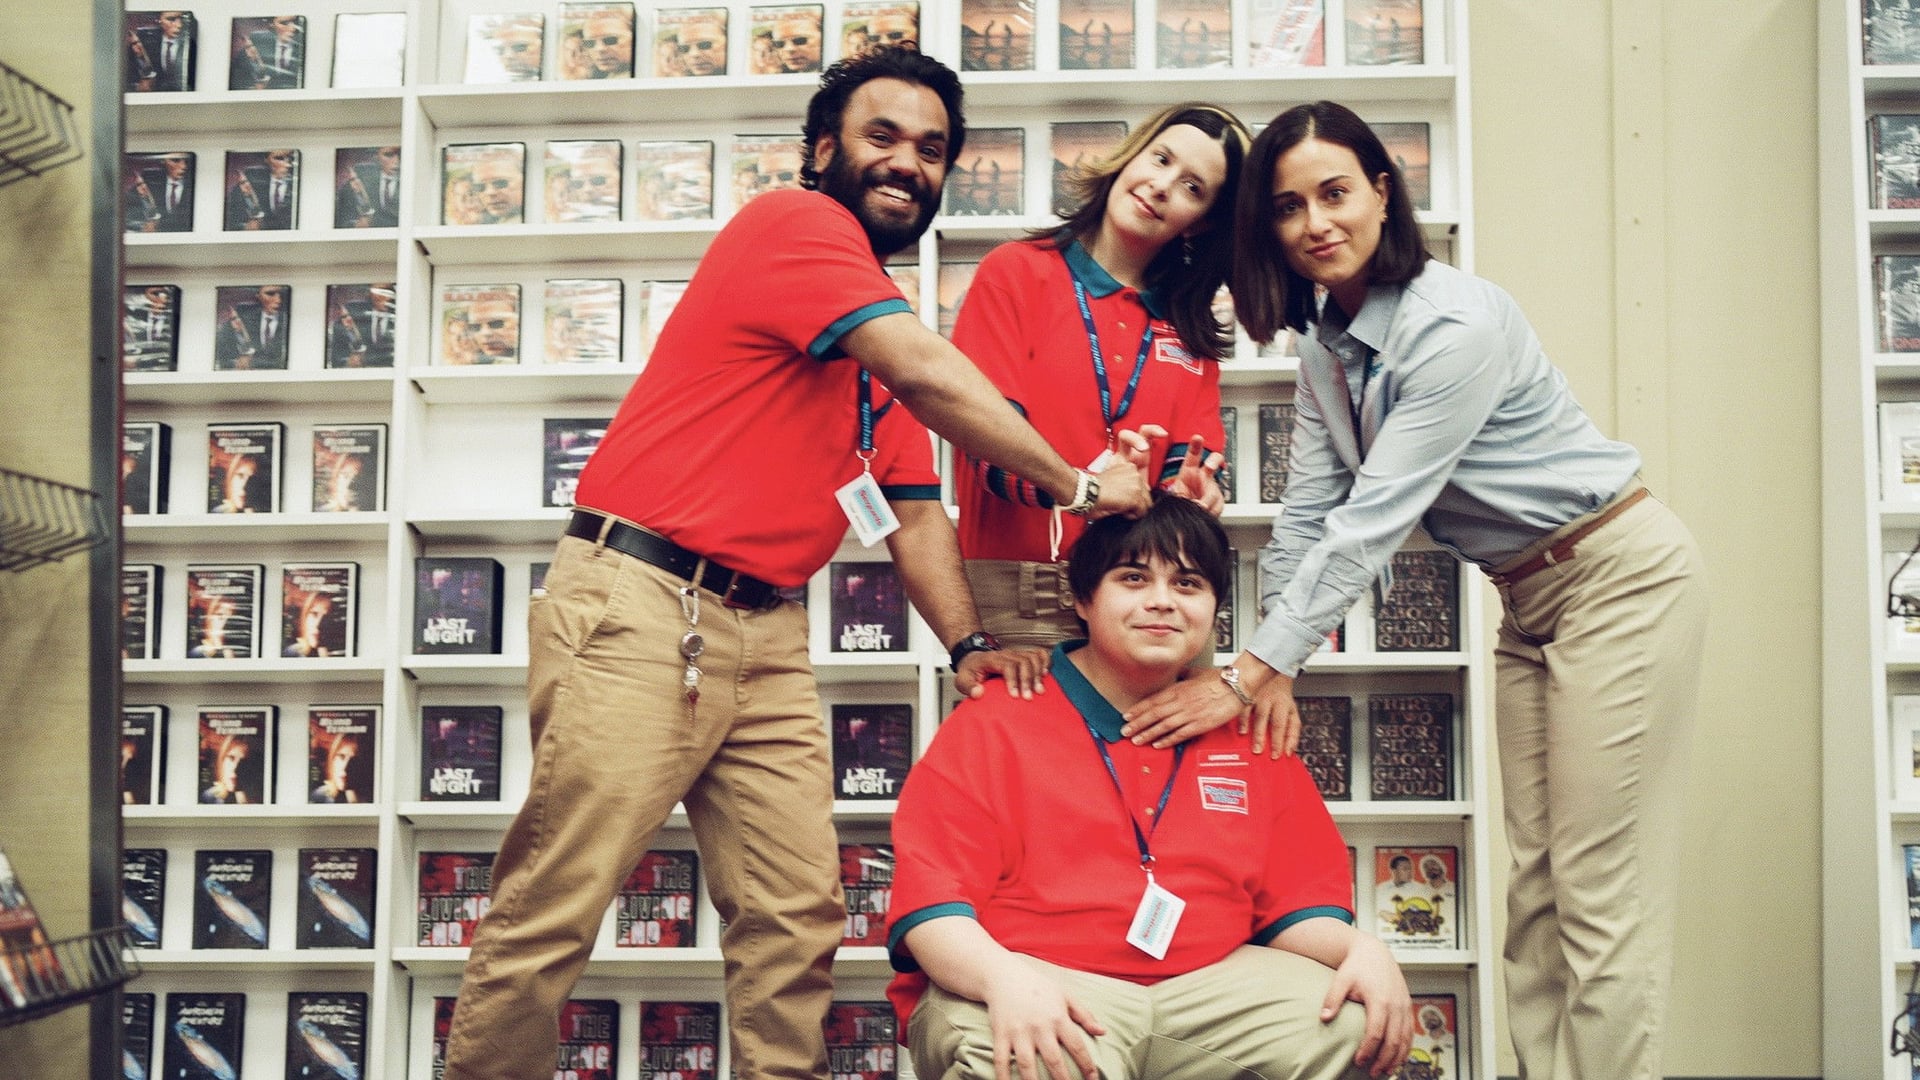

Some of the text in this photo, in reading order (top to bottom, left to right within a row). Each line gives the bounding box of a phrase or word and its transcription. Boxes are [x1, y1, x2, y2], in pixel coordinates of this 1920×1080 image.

[427, 618, 469, 630] LAST
[843, 624, 884, 636] LAST
[424, 628, 477, 646] NIGHT
[840, 634, 893, 651] NIGHT
[1377, 634, 1451, 649] GOULD
[433, 768, 475, 780] LAST
[846, 768, 887, 780] LAST
[430, 778, 483, 796] NIGHT
[842, 778, 895, 796] NIGHT
[1373, 781, 1444, 795] GOULD
[453, 866, 492, 890] THE
[653, 865, 692, 890] THE
[617, 895, 690, 920] LIVING
[571, 1014, 611, 1039] THE
[675, 1014, 715, 1040] THE
